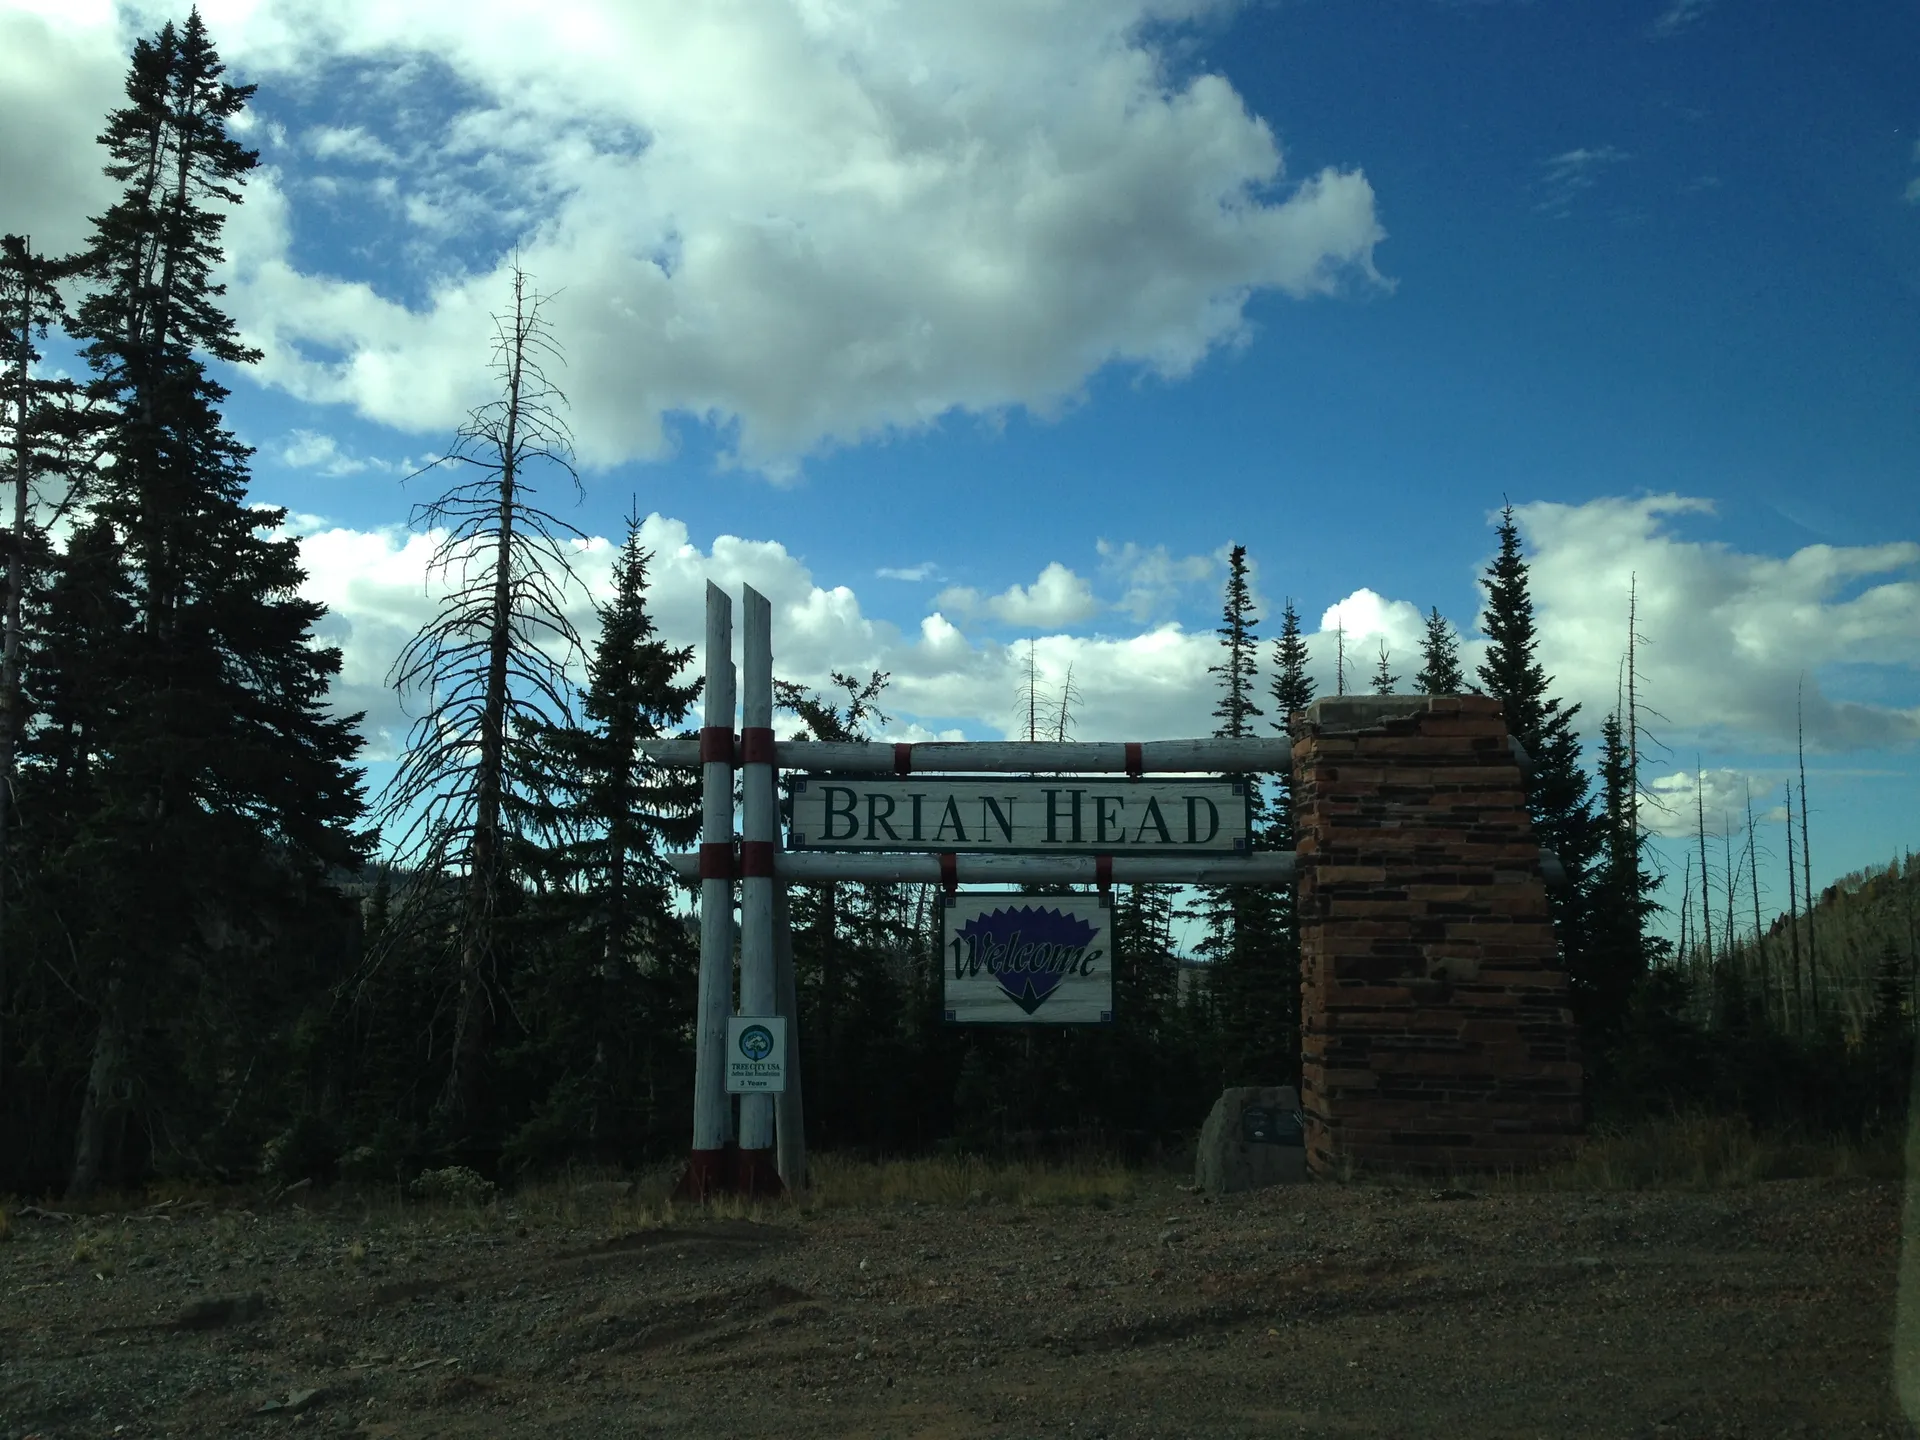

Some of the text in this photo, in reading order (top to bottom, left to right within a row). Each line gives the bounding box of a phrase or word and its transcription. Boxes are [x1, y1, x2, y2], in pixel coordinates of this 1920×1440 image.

[818, 786, 1219, 844] BRIAN HEAD
[948, 929, 1103, 980] Welcome
